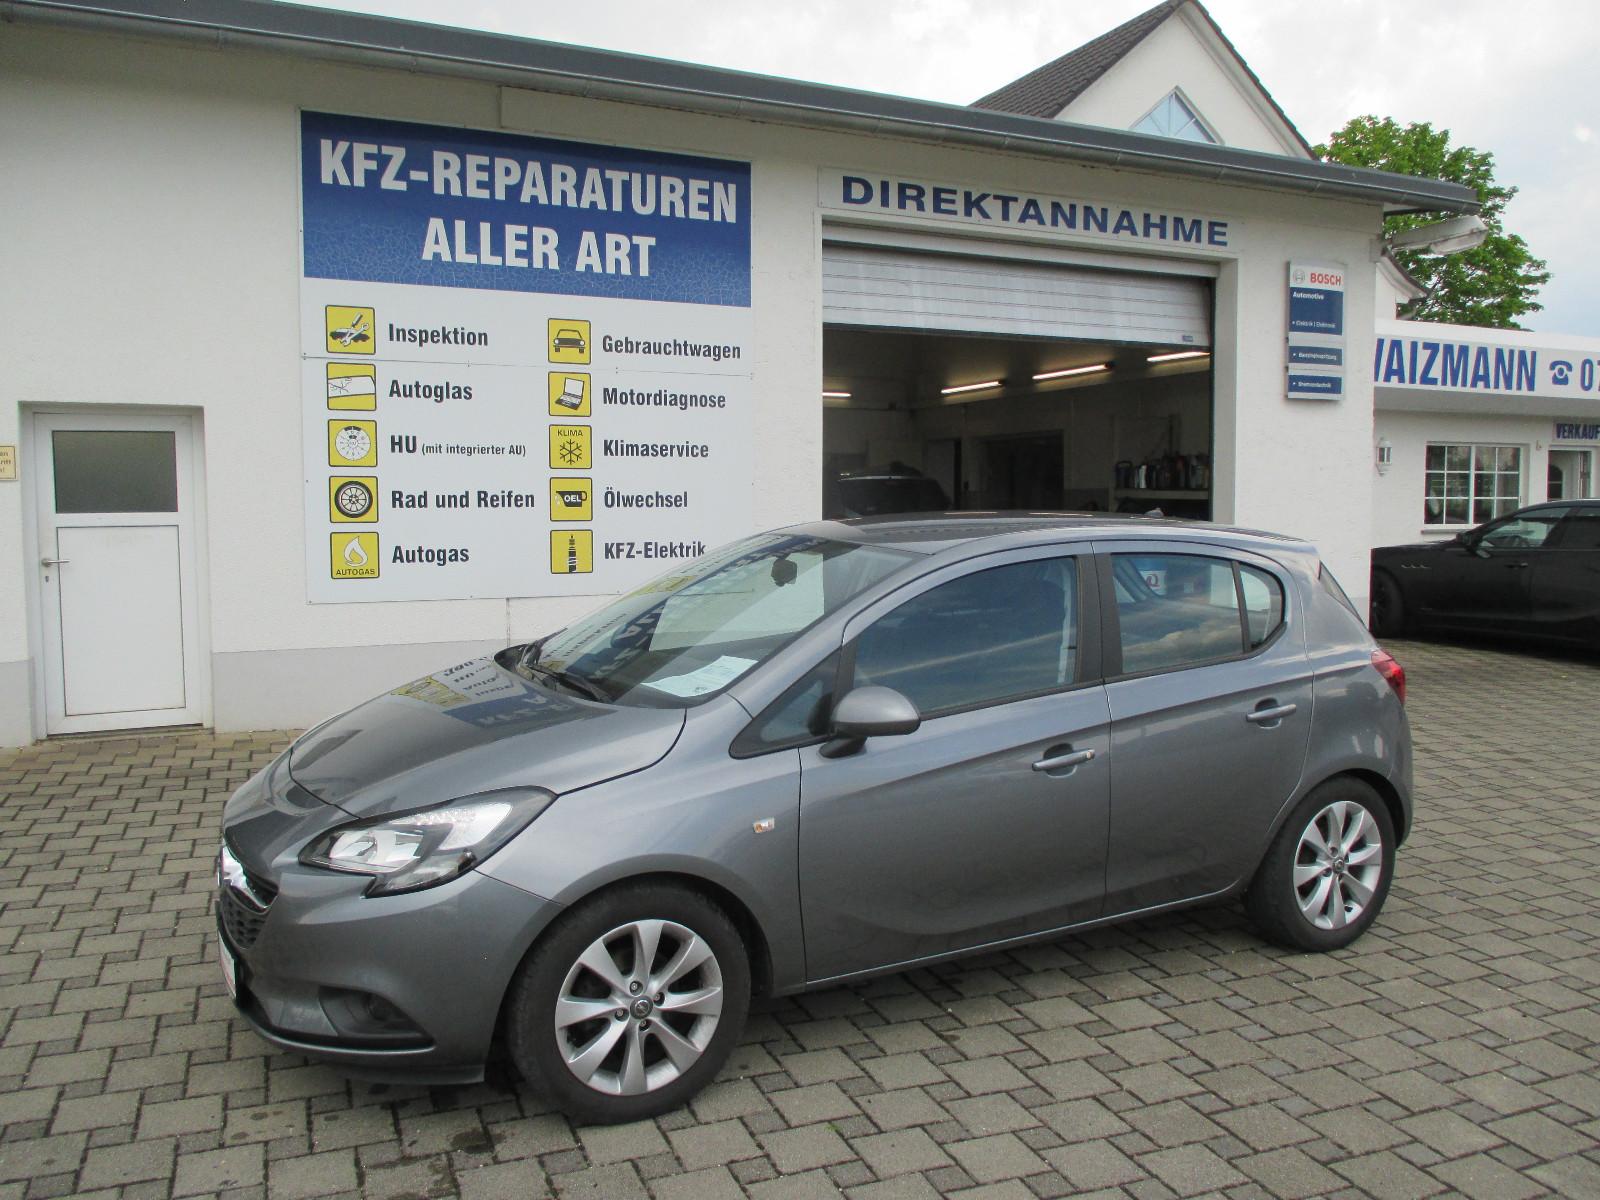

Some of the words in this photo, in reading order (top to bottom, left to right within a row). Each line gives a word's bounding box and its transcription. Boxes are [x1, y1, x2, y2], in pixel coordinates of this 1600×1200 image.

[320, 138, 737, 223] KFZ-REPARATUREN
[842, 175, 1228, 246] DIREKTANNAHME
[422, 218, 559, 270] ALLER
[576, 231, 655, 276] ART
[1310, 273, 1341, 286] BOSCH
[389, 324, 488, 347] Inspektion
[603, 335, 740, 361] Gebrauchtwagen
[389, 380, 472, 403] Autoglas
[603, 388, 725, 410] Motordiagnose
[557, 428, 584, 437] KLIMA
[391, 435, 416, 453] HU
[421, 444, 443, 457] (mit
[446, 443, 506, 457] integrierter
[508, 444, 527, 457] AU)
[604, 440, 708, 457] Klimaservice
[392, 491, 427, 508] Rad
[436, 491, 469, 508] und
[477, 491, 534, 508] Reifen
[563, 495, 581, 503] OEL
[604, 487, 687, 508] Ölwechsel
[392, 546, 469, 566] Autogas
[605, 541, 705, 559] KFZ-Elektrik
[335, 568, 376, 576] AUTOGAS
